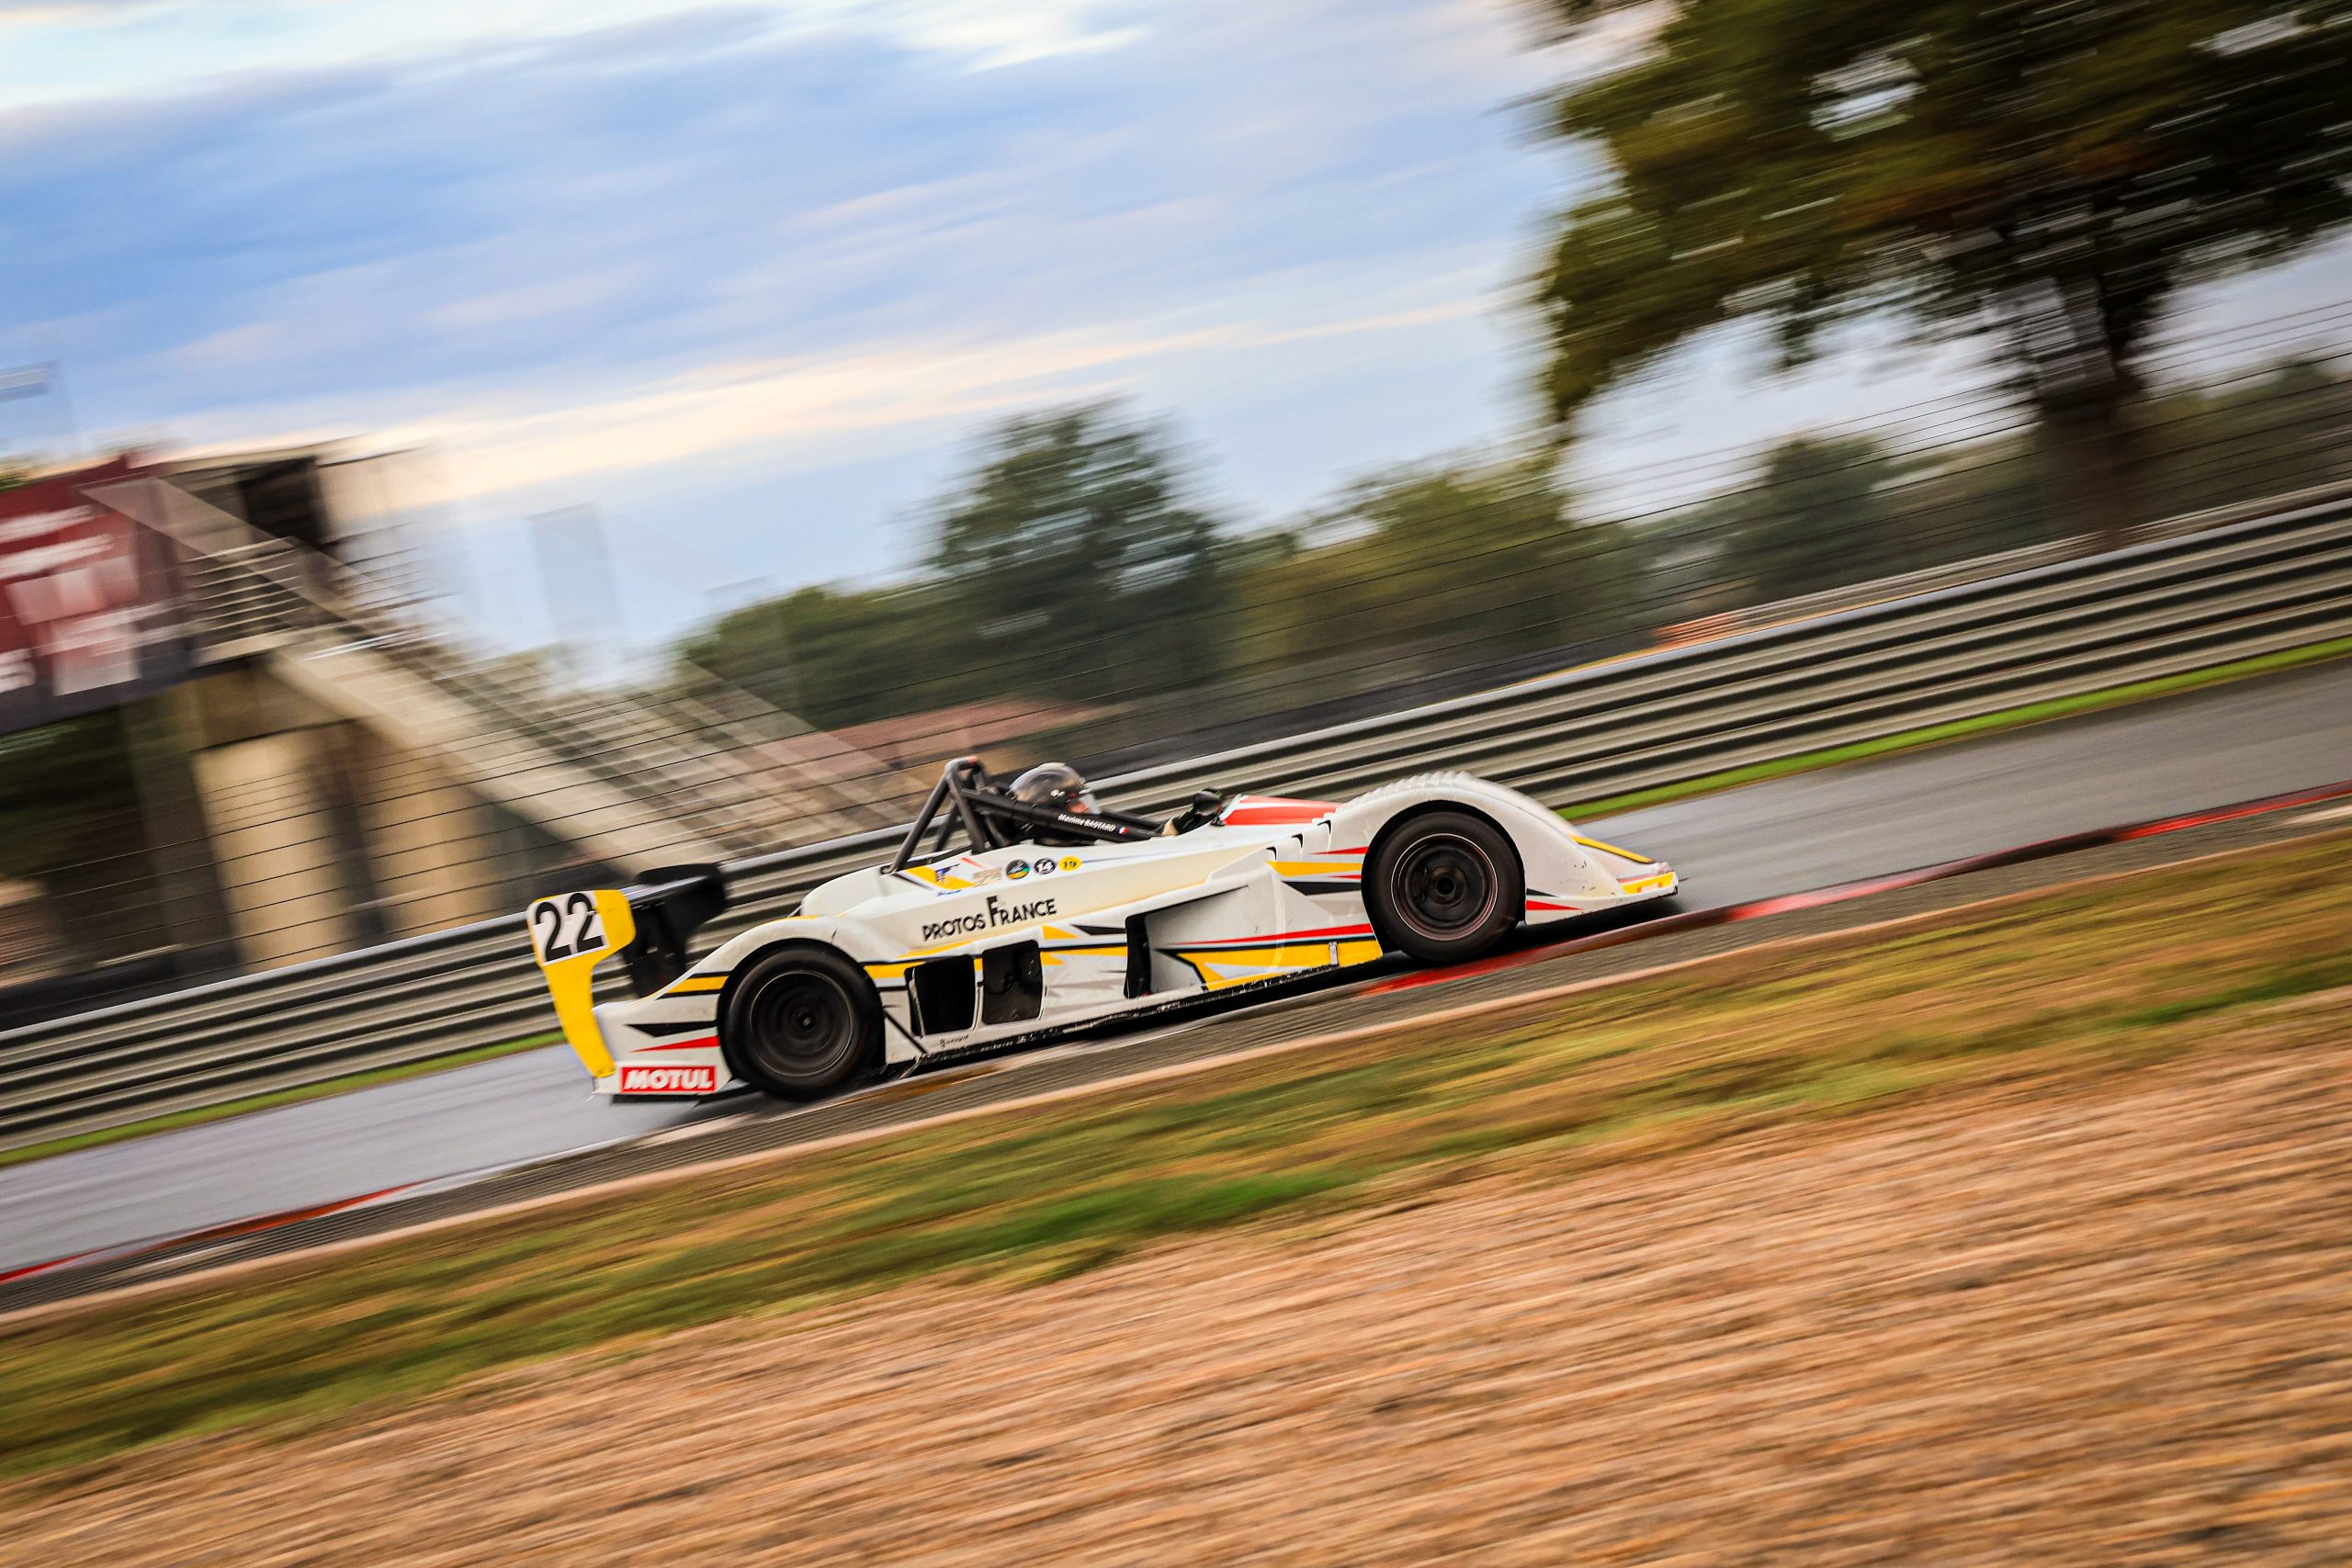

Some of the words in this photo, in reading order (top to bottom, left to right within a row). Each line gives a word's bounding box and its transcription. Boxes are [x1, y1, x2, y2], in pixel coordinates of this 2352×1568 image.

[1083, 818, 1116, 832] BASTARD
[536, 893, 604, 962] 22
[922, 913, 986, 942] PROTOS
[986, 895, 1057, 928] FRANCE
[623, 1068, 714, 1089] MOTUL
